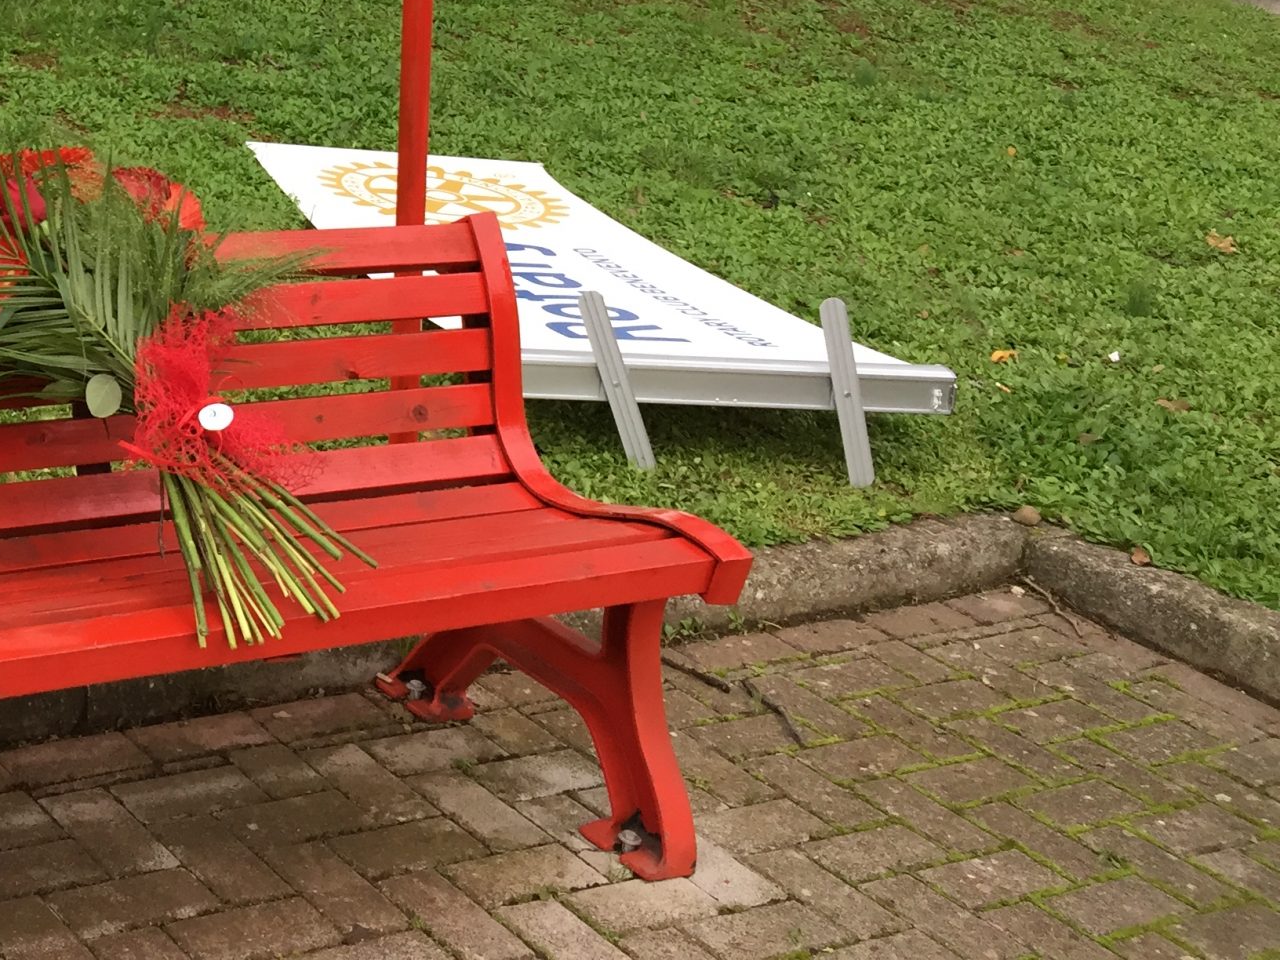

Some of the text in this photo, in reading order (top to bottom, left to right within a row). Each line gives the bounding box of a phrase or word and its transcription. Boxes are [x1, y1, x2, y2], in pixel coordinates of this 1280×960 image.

[504, 242, 692, 343] Rota
[572, 247, 780, 347] ROTARY CLUB BENEVENTO
